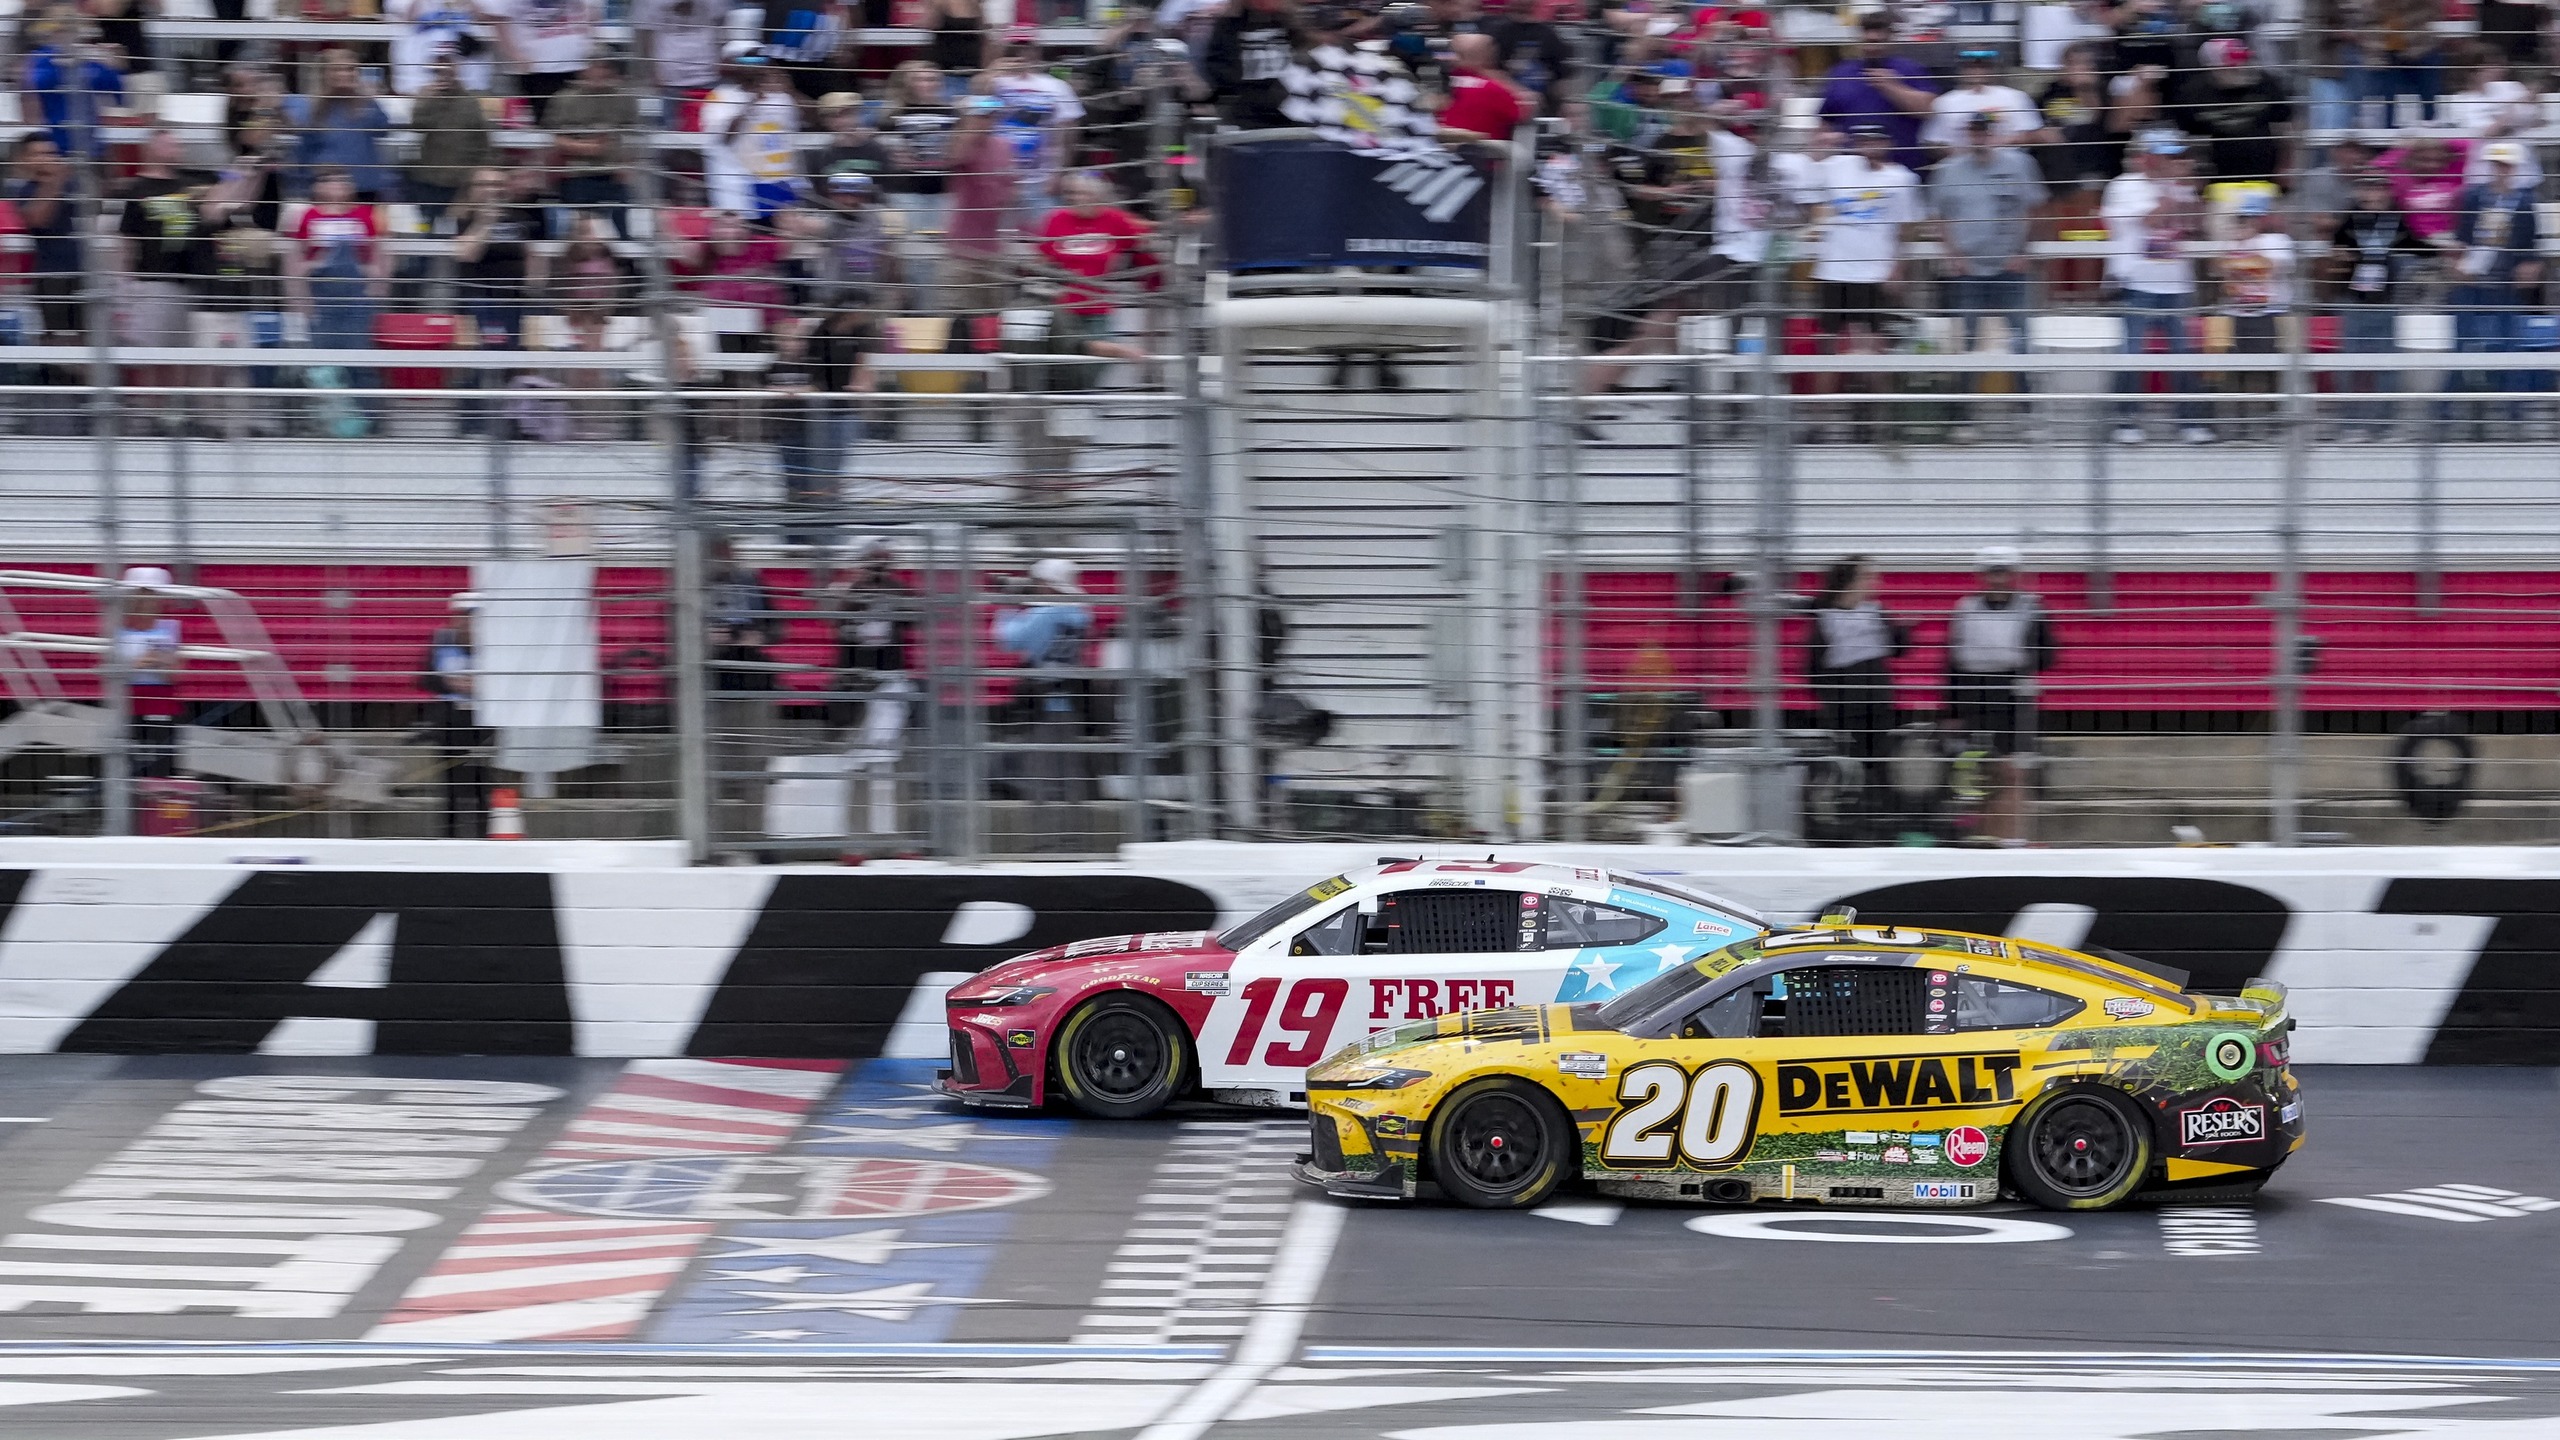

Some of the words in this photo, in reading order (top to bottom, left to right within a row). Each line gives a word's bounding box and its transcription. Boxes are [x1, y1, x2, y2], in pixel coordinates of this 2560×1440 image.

[1696, 921, 1730, 934] Lance
[1080, 972, 1161, 990] GOODYEAR
[1369, 979, 1514, 1019] FREE
[1225, 978, 1349, 1067] 19
[1602, 1060, 1763, 1170] 20
[2187, 1109, 2260, 1141] RESER'S
[1857, 1151, 1881, 1160] Flow
[1950, 1128, 1985, 1160] Rheem
[1915, 1184, 1957, 1197] Mobil
[1961, 1185, 1973, 1197] 1
